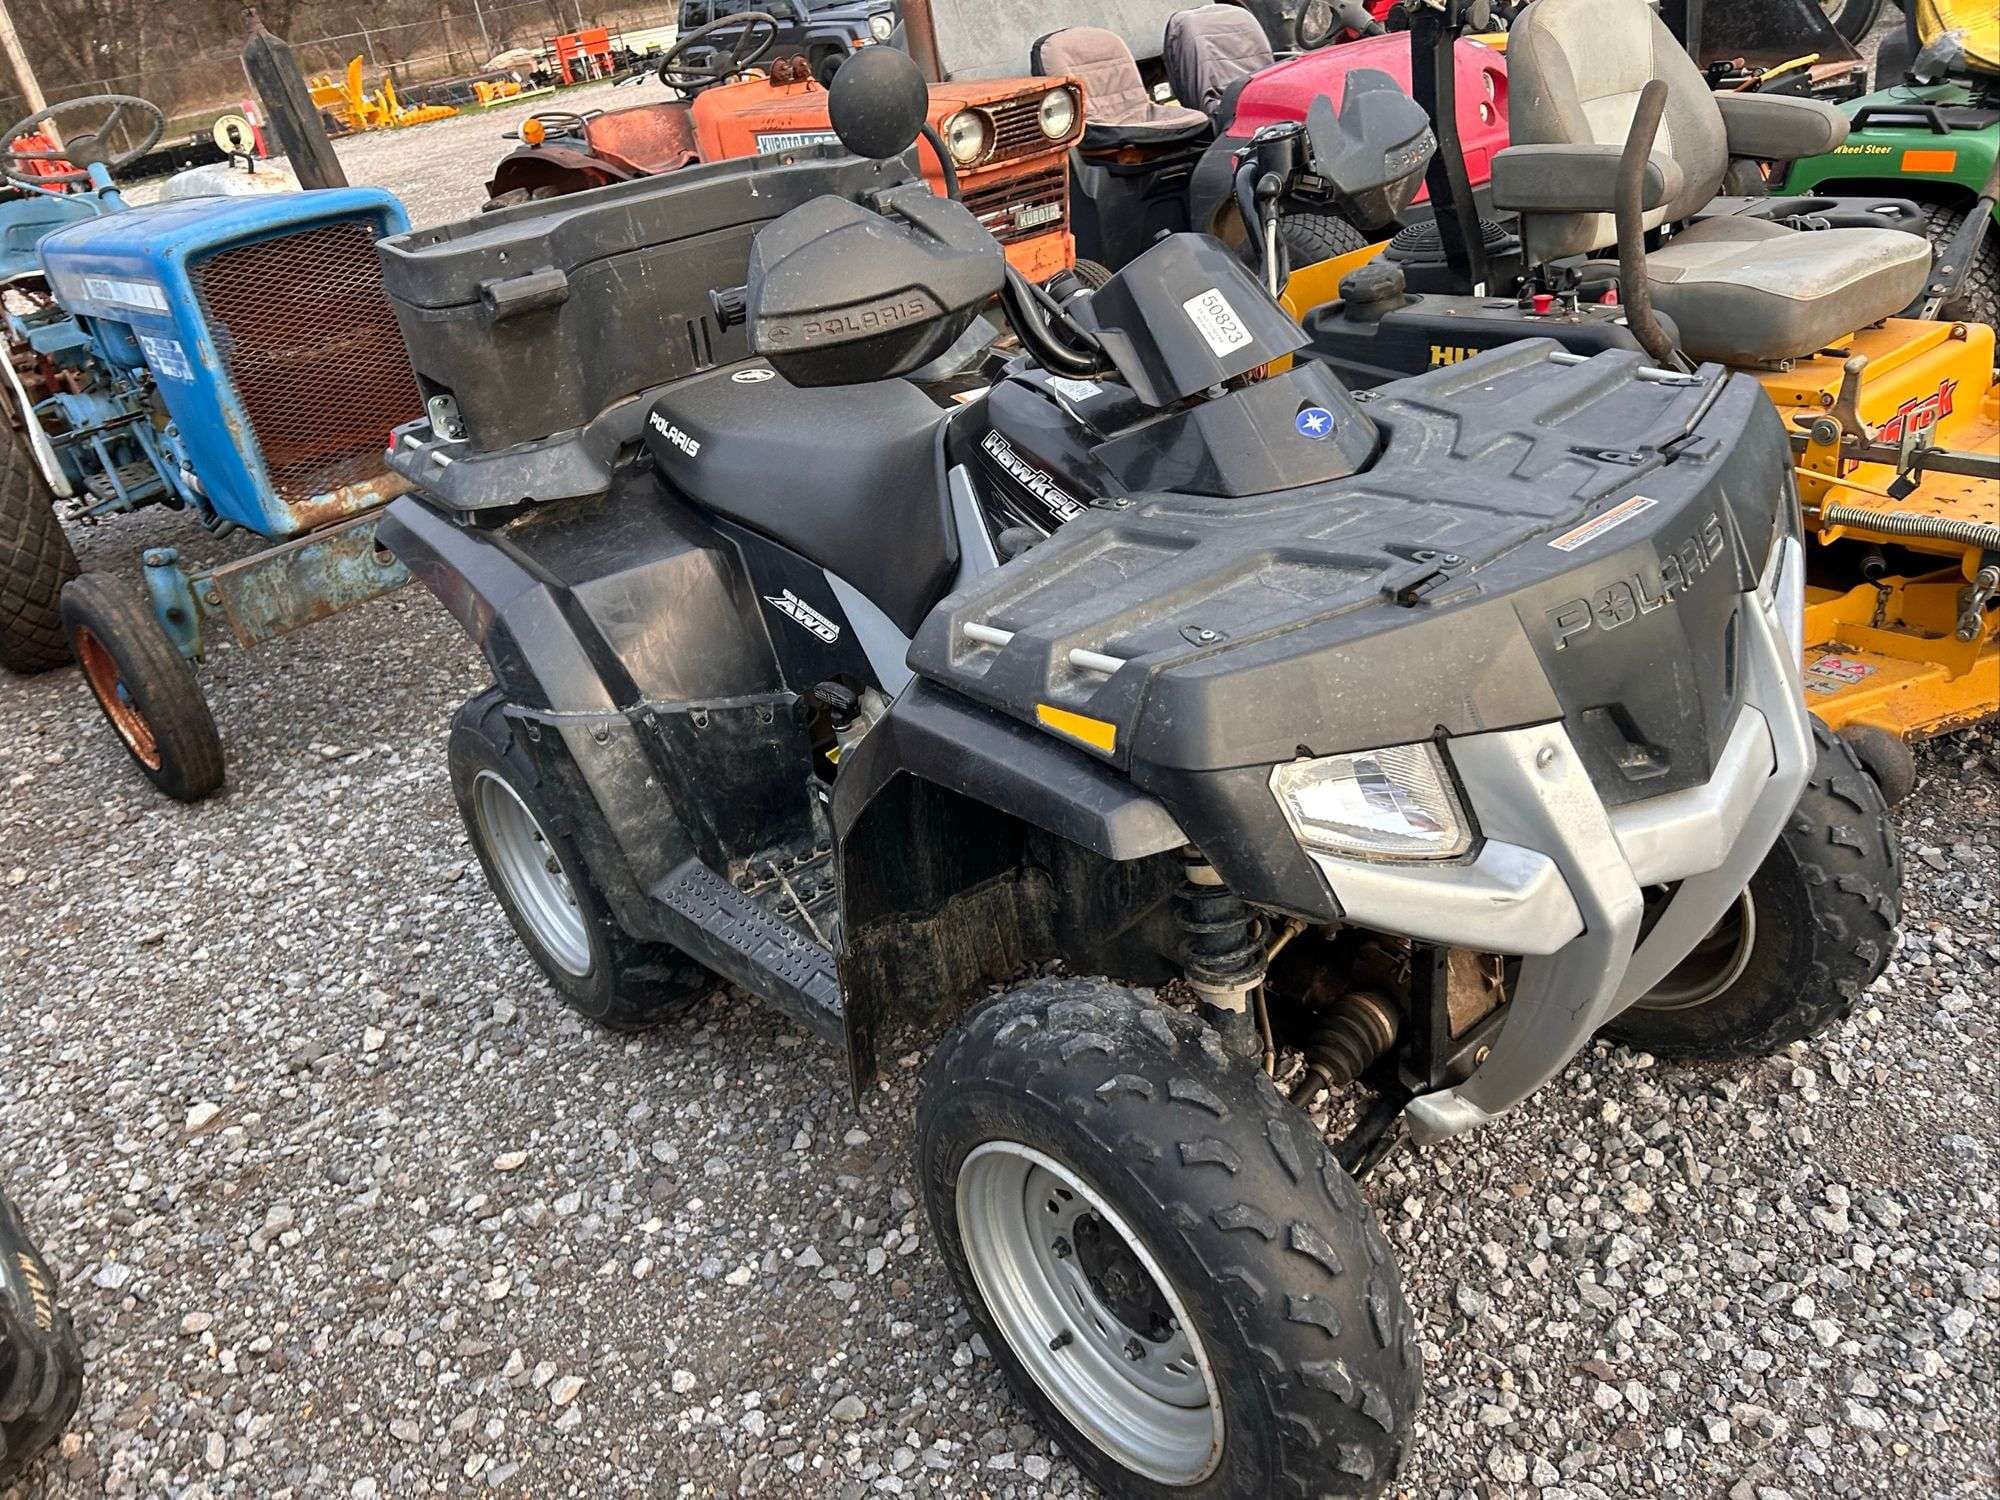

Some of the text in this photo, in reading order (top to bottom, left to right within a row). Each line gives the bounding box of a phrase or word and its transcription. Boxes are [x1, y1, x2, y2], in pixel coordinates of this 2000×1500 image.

[1864, 144, 1893, 154] Steer
[803, 298, 925, 340] POLARIS
[1202, 295, 1244, 344] 50823
[649, 411, 701, 458] POLARIS
[981, 429, 1088, 524] Hawkey
[1544, 511, 1725, 652] POLARIS
[766, 597, 838, 643] AWD
